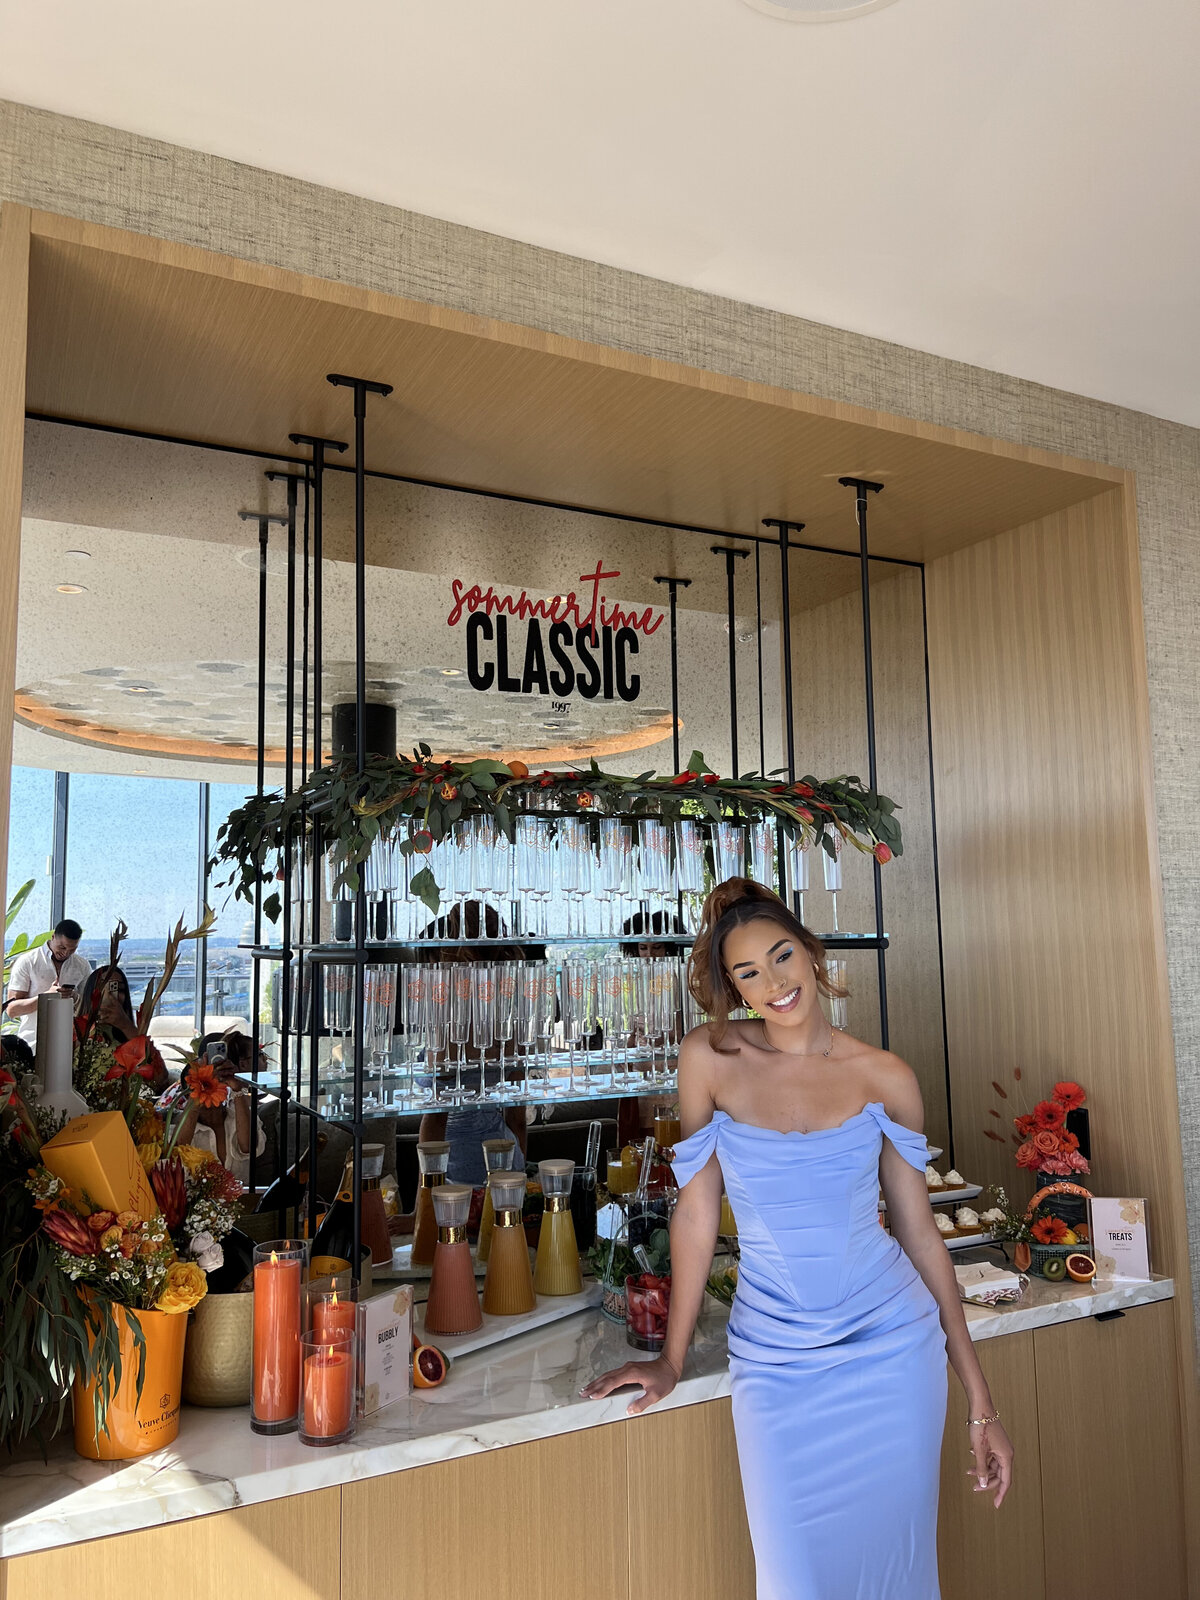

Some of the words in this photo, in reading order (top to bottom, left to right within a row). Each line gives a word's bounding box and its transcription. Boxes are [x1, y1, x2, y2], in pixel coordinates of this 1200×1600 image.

[447, 560, 664, 646] sommertime
[466, 611, 641, 702] CLASSIC
[551, 701, 571, 713] 1997
[1108, 1232, 1133, 1241] TREATS
[377, 1326, 399, 1344] BUBBLY
